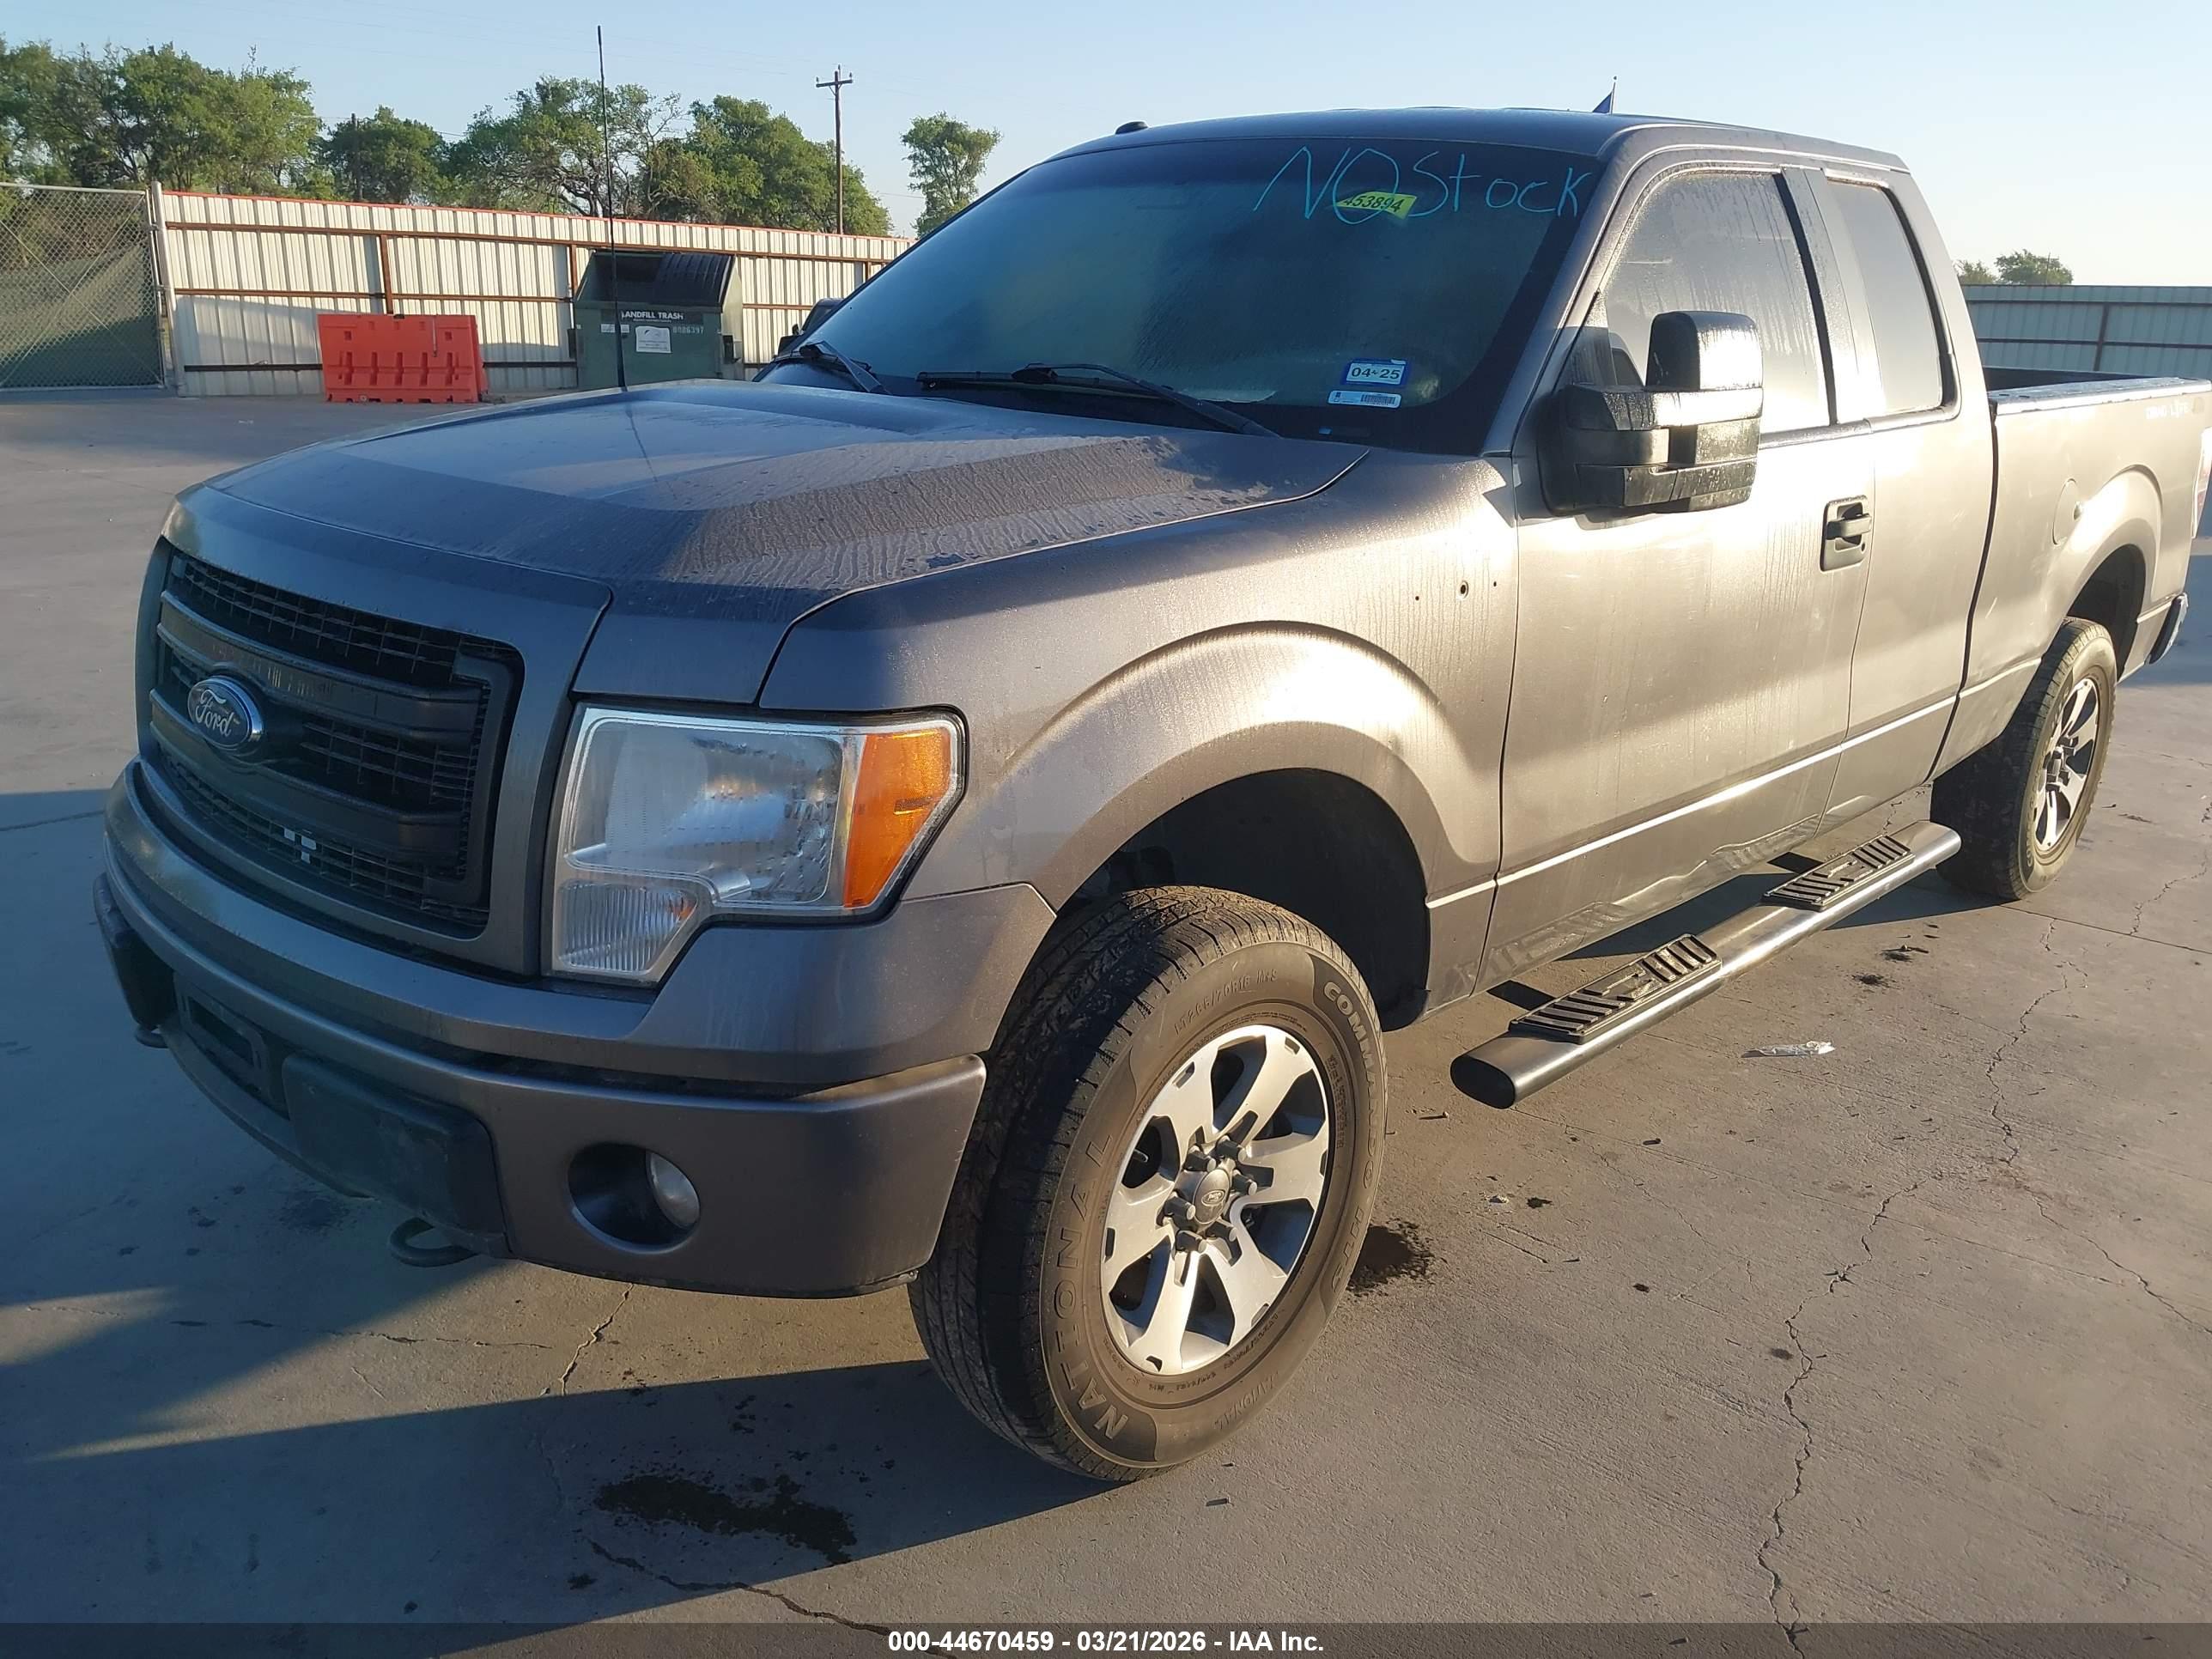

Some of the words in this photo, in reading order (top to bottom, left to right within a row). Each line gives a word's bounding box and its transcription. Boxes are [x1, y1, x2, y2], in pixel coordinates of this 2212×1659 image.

[1252, 145, 1401, 225] NO
[622, 310, 656, 319] LANDFILL
[658, 312, 684, 320] TRASH
[195, 689, 234, 738] Ford
[1053, 1133, 1128, 1440] NATIONAL
